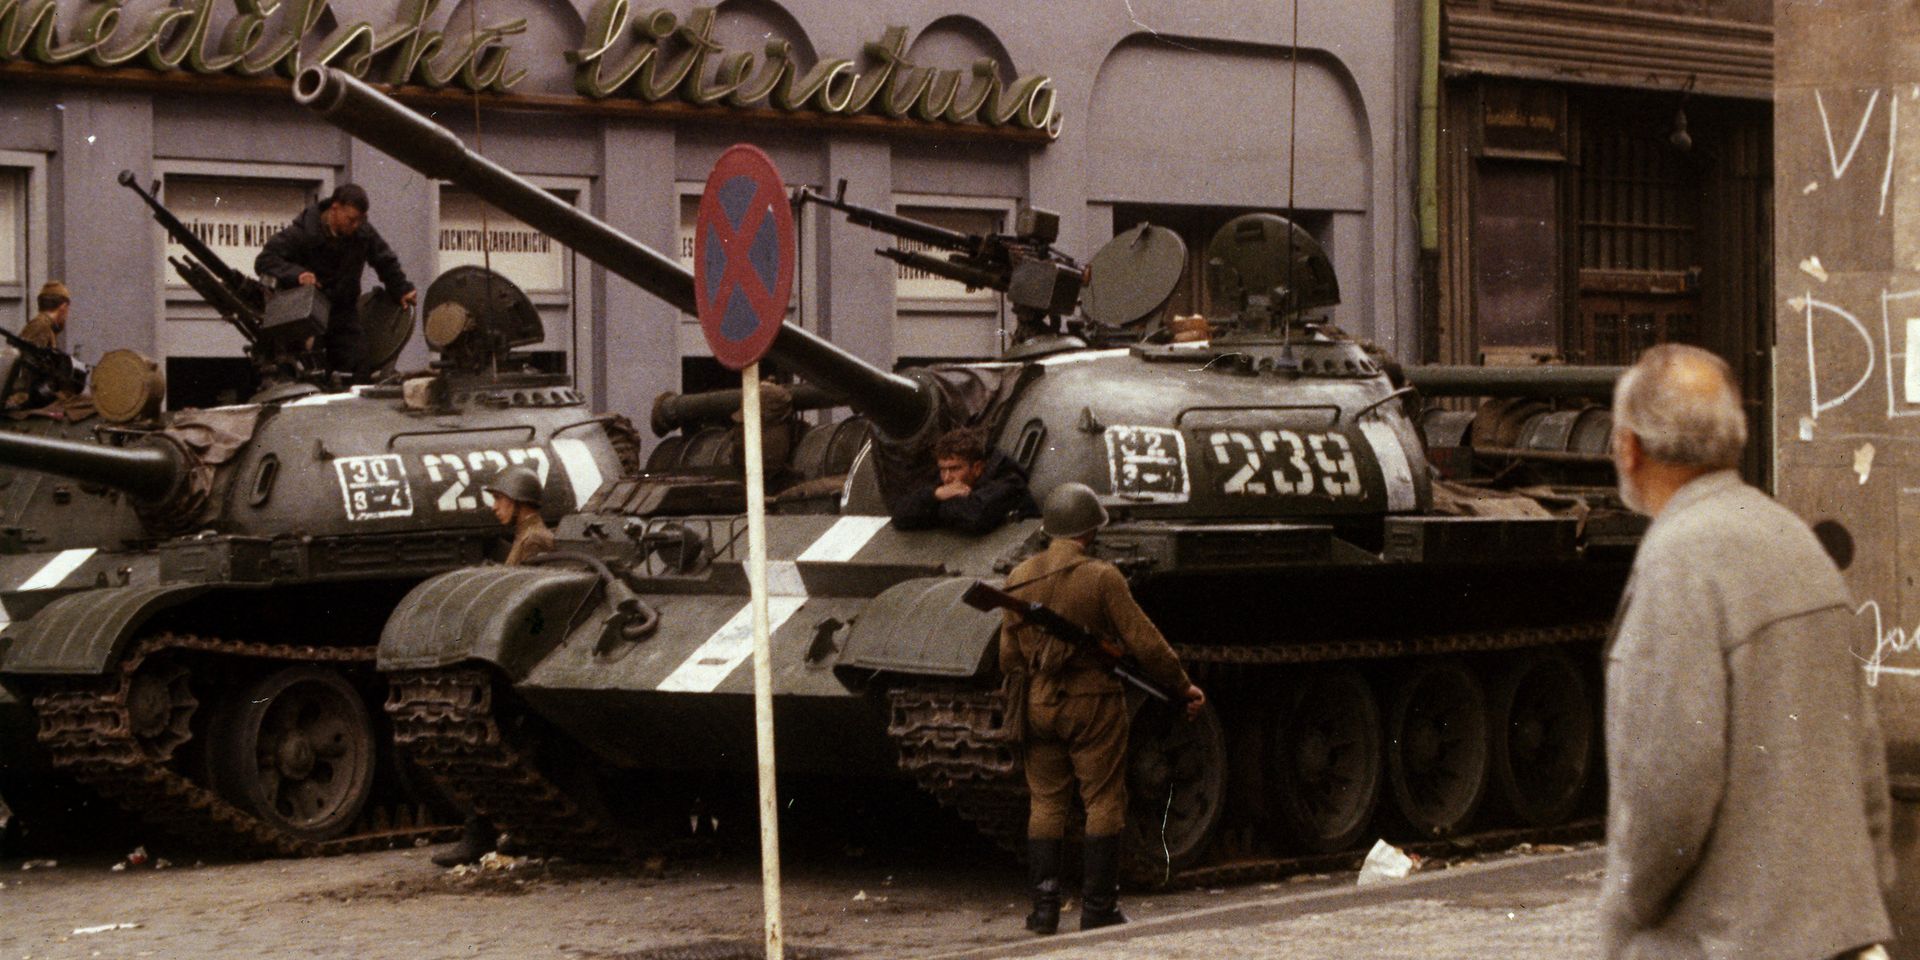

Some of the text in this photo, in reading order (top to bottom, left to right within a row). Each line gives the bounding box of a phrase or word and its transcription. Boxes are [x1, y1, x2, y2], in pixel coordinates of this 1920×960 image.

[564, 0, 1063, 140] literatura
[168, 217, 285, 248] ÁNY PRO MLÁD
[350, 459, 389, 482] 30
[1210, 429, 1362, 496] 239
